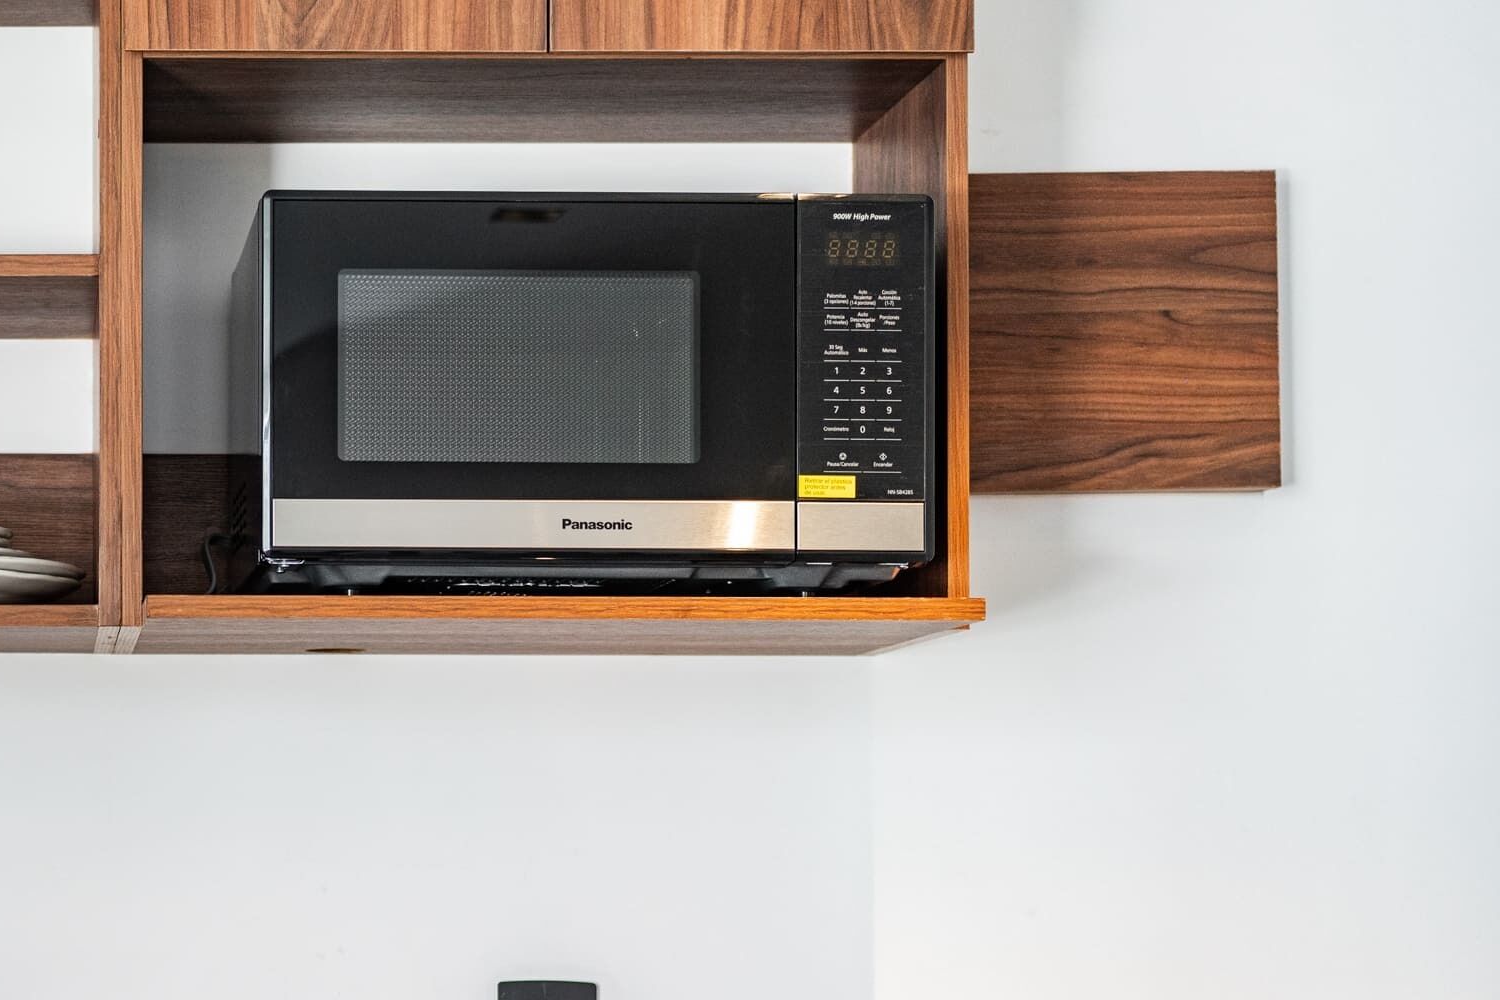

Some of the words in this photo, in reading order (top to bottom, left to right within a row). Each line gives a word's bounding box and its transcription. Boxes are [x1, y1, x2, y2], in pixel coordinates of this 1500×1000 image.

[853, 213, 869, 221] High
[860, 367, 866, 375] 2
[886, 367, 892, 375] 3
[833, 386, 839, 394] 4
[860, 386, 866, 394] 5
[860, 406, 866, 414] 8
[887, 406, 892, 414] 9
[860, 425, 866, 433] 0
[562, 519, 633, 530] Panasonic
